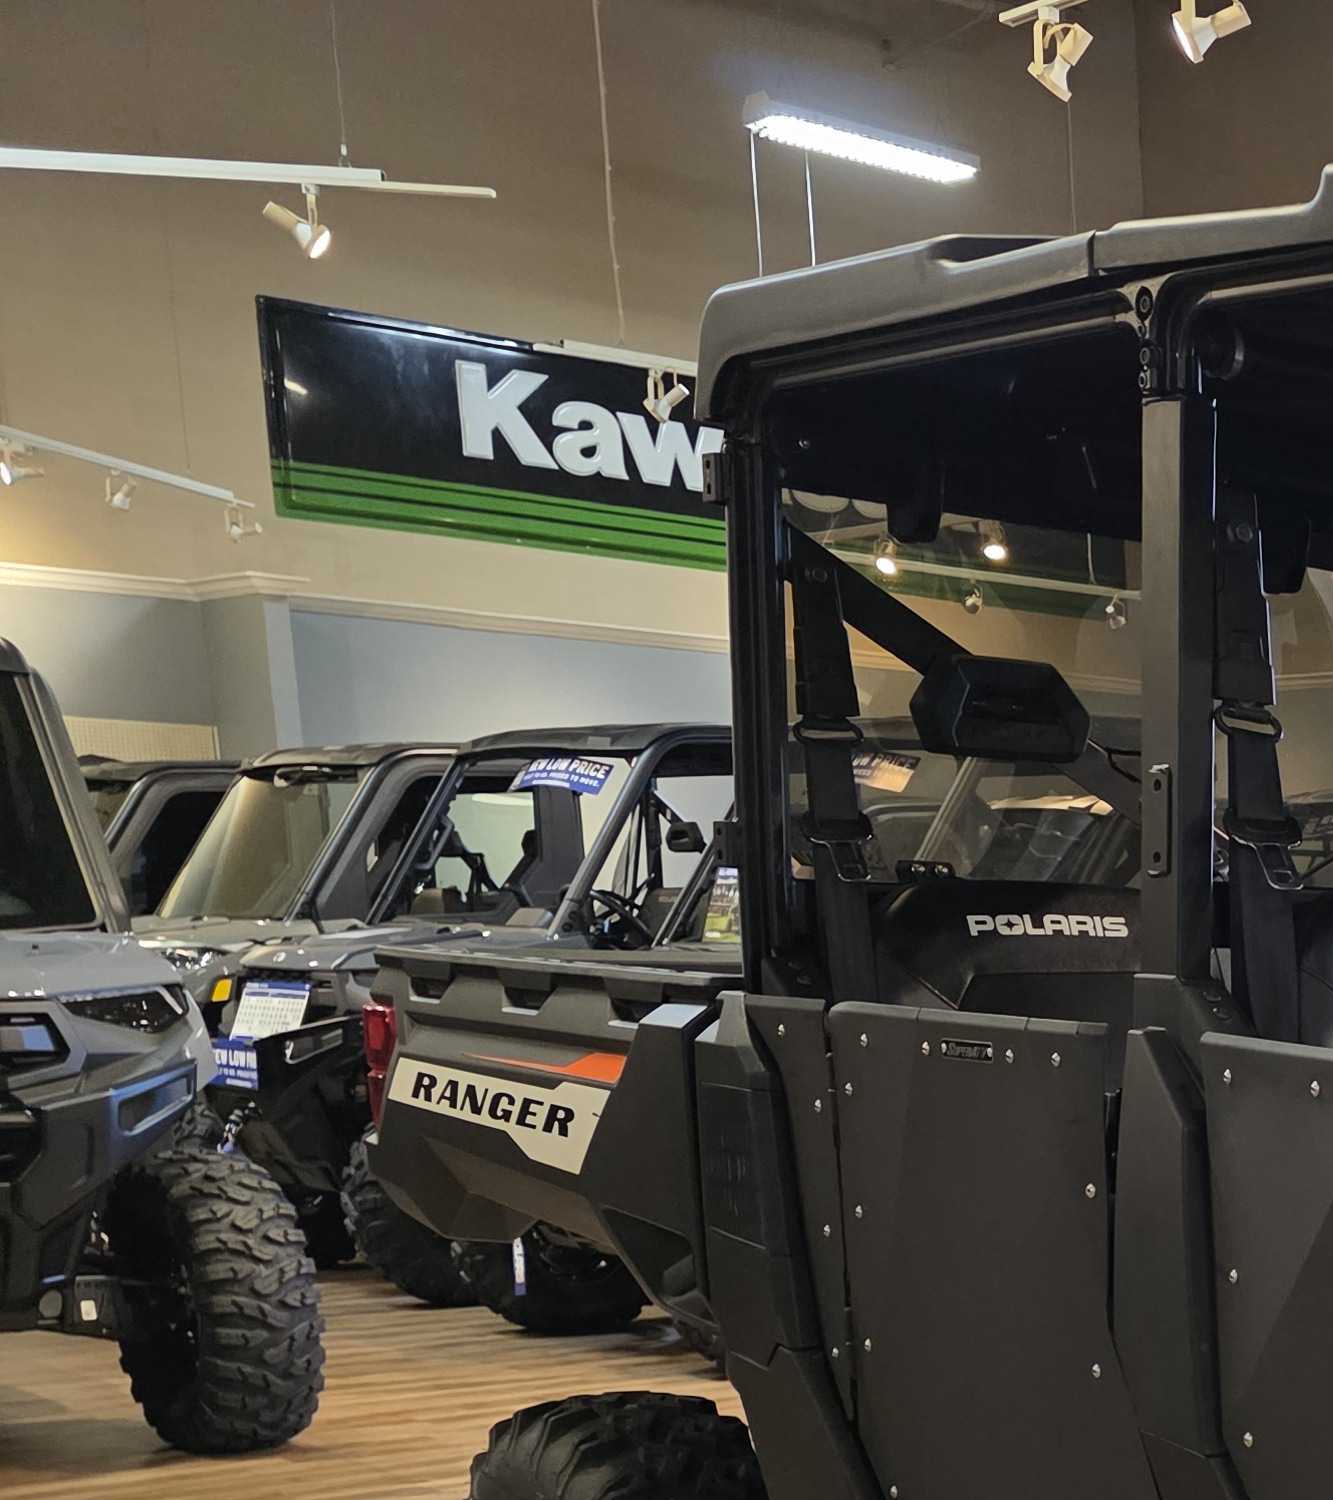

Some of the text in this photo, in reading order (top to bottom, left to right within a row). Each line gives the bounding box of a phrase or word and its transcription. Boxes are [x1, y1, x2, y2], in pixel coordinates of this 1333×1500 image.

[567, 759, 610, 779] PRICE
[966, 914, 1129, 937] POLARIS
[411, 1071, 575, 1138] RANGER
